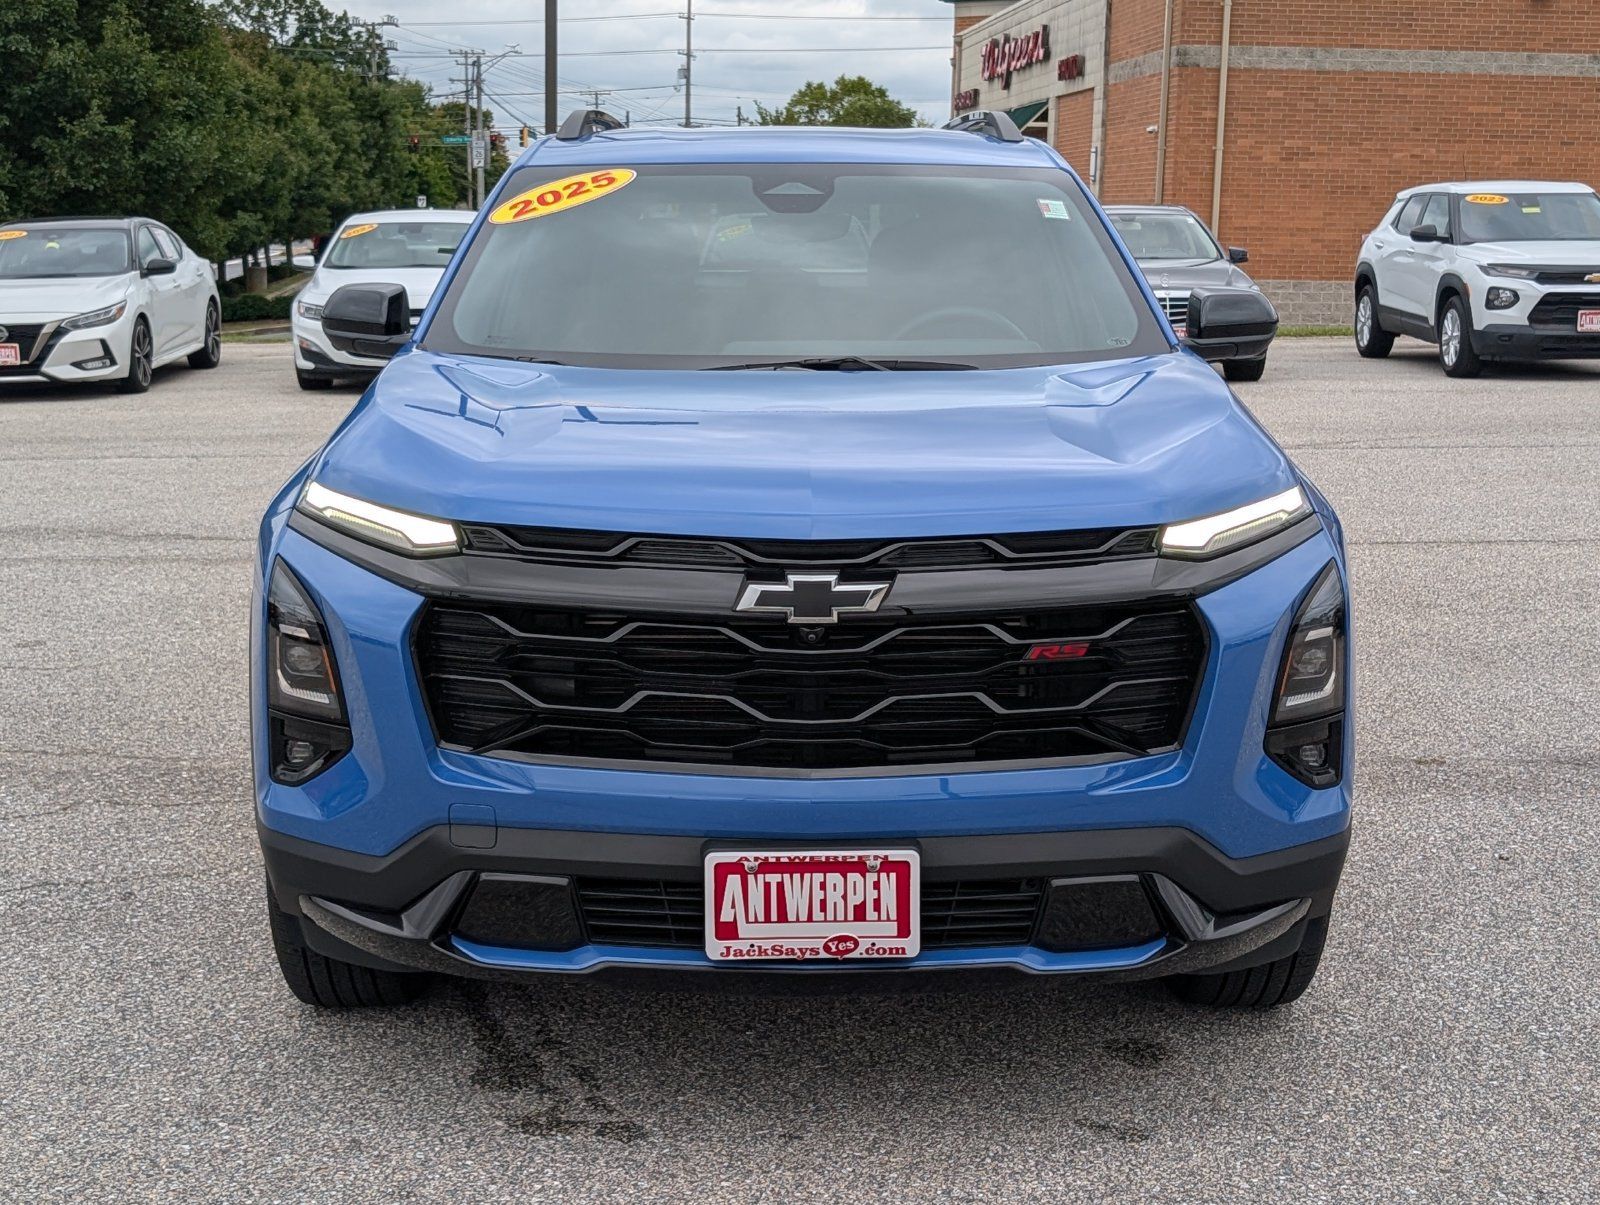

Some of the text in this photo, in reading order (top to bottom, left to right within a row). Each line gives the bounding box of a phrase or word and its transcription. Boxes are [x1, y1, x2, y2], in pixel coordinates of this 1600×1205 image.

[509, 172, 616, 219] 2025
[1023, 642, 1089, 660] RS
[719, 872, 898, 923] ANTWERPEN
